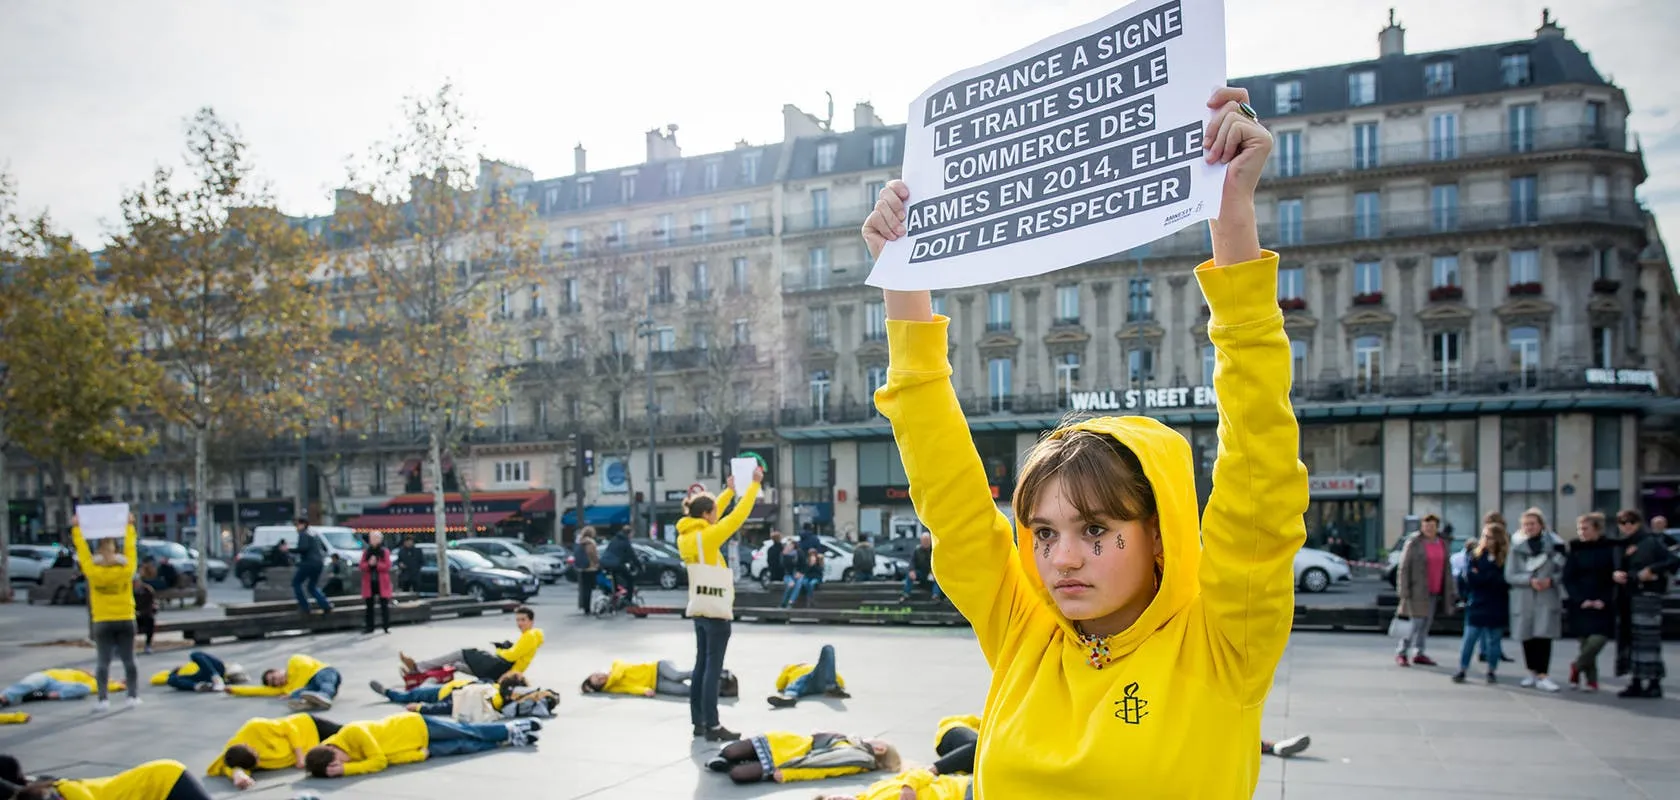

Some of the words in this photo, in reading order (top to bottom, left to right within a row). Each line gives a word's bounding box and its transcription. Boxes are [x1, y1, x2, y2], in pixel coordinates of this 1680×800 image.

[930, 92, 956, 119] LA
[965, 53, 1063, 106] FRANCE
[1071, 46, 1088, 70] A
[1097, 6, 1182, 59] SIGNE
[934, 124, 962, 151] LE
[971, 94, 1059, 140] TRAITE
[1068, 73, 1123, 110] SUR
[1134, 55, 1167, 87] LE
[907, 190, 990, 233] ARMES
[1000, 178, 1033, 204] EN
[1043, 156, 1120, 196] 2014,
[1131, 128, 1203, 170] ELLE
[944, 122, 1090, 184] COMMERCE
[1099, 103, 1154, 140] DES
[911, 230, 970, 260] DOIT
[977, 221, 1007, 247] LE
[1017, 177, 1180, 238] RESPECTER
[1071, 391, 1120, 410] WALL
